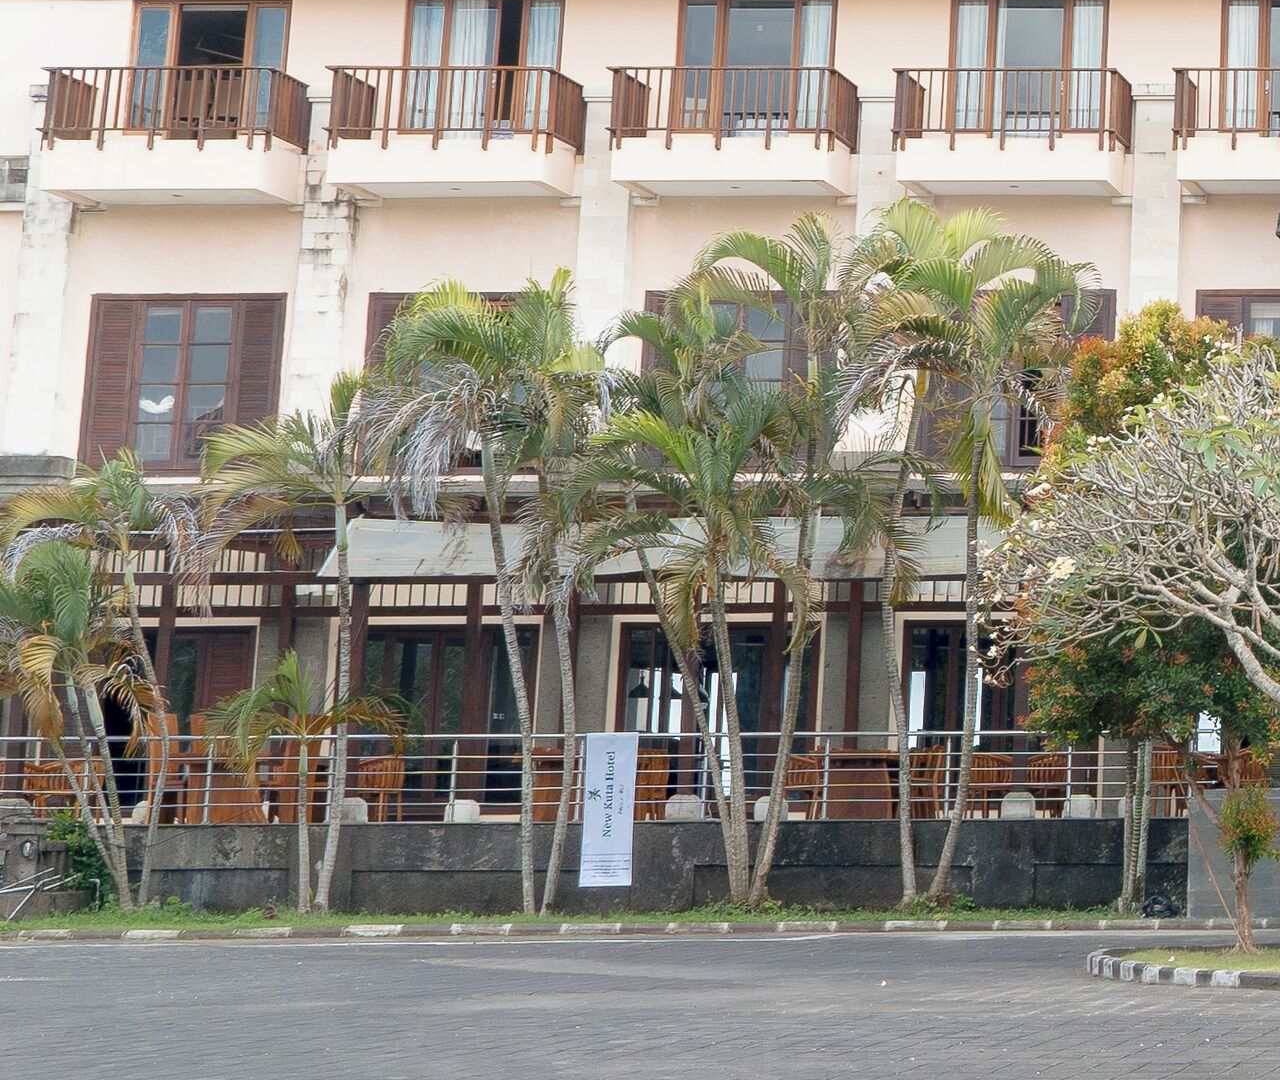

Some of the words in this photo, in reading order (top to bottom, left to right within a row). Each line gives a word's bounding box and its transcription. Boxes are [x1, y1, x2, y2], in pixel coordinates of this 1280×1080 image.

[606, 751, 616, 781] Hotel
[603, 784, 614, 810] Kuta
[603, 813, 612, 837] New
